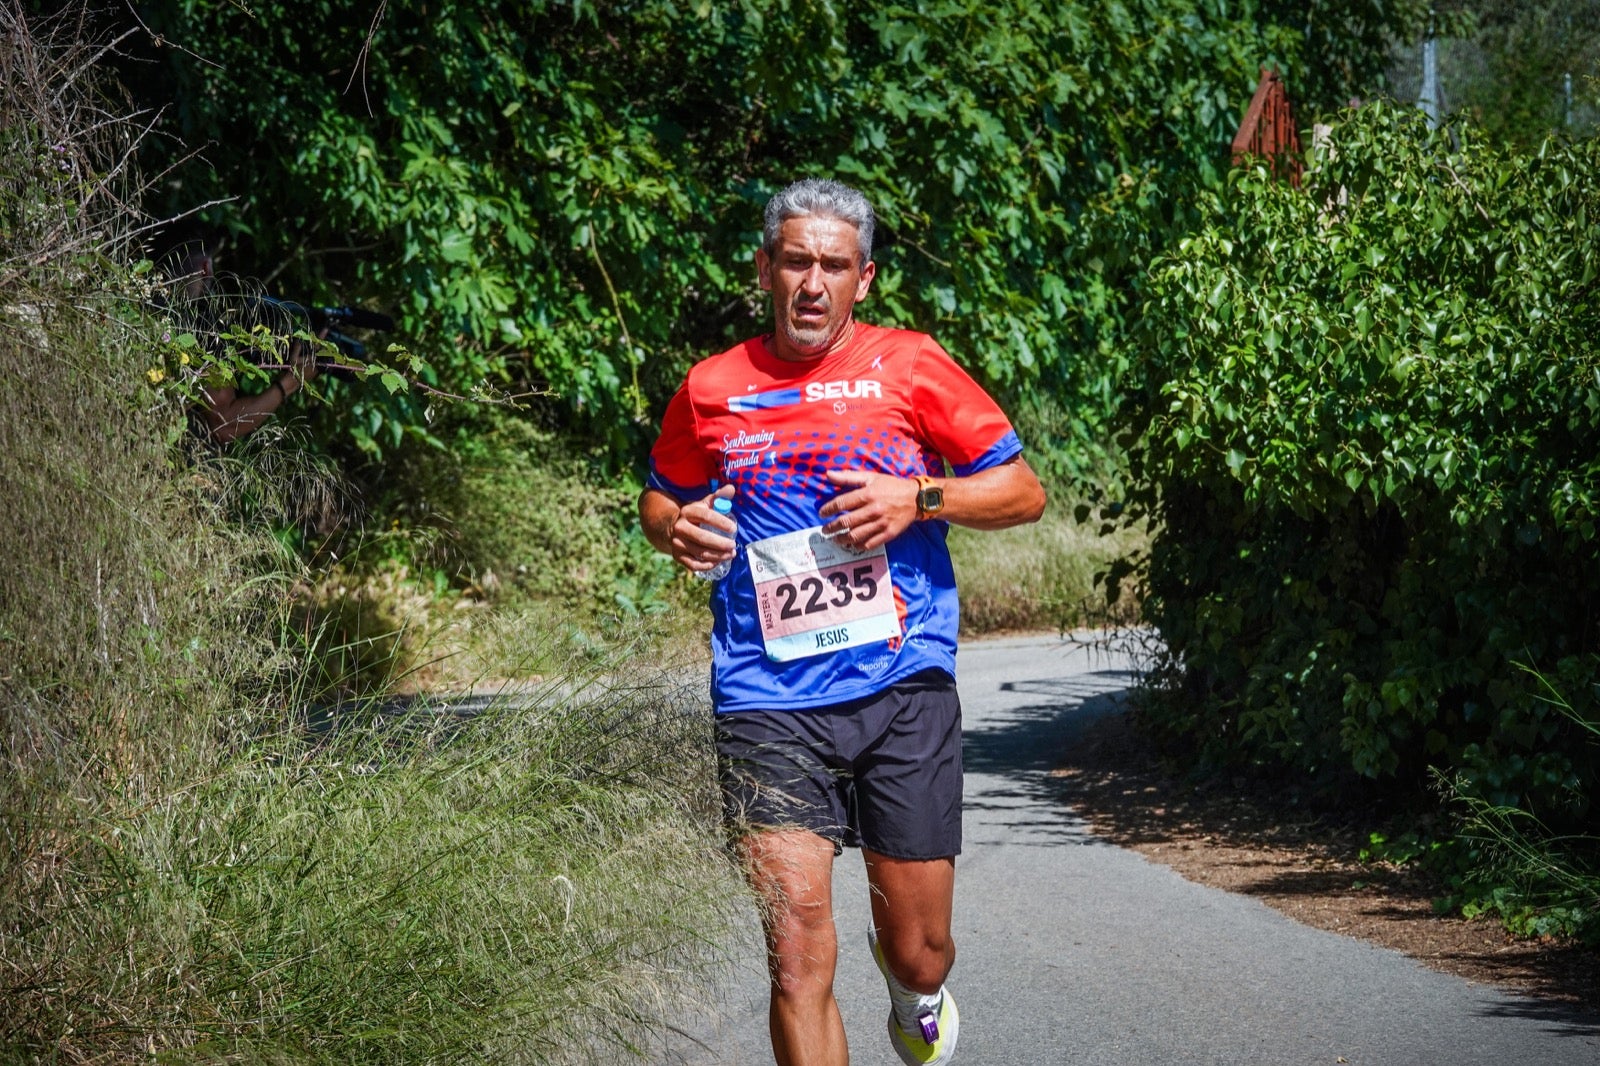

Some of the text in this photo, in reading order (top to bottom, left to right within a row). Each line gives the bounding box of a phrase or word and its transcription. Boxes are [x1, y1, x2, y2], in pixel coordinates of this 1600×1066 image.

[805, 380, 882, 402] SEUR
[776, 565, 878, 621] 2235
[762, 599, 773, 630] MASTER
[815, 628, 849, 648] JESUS
